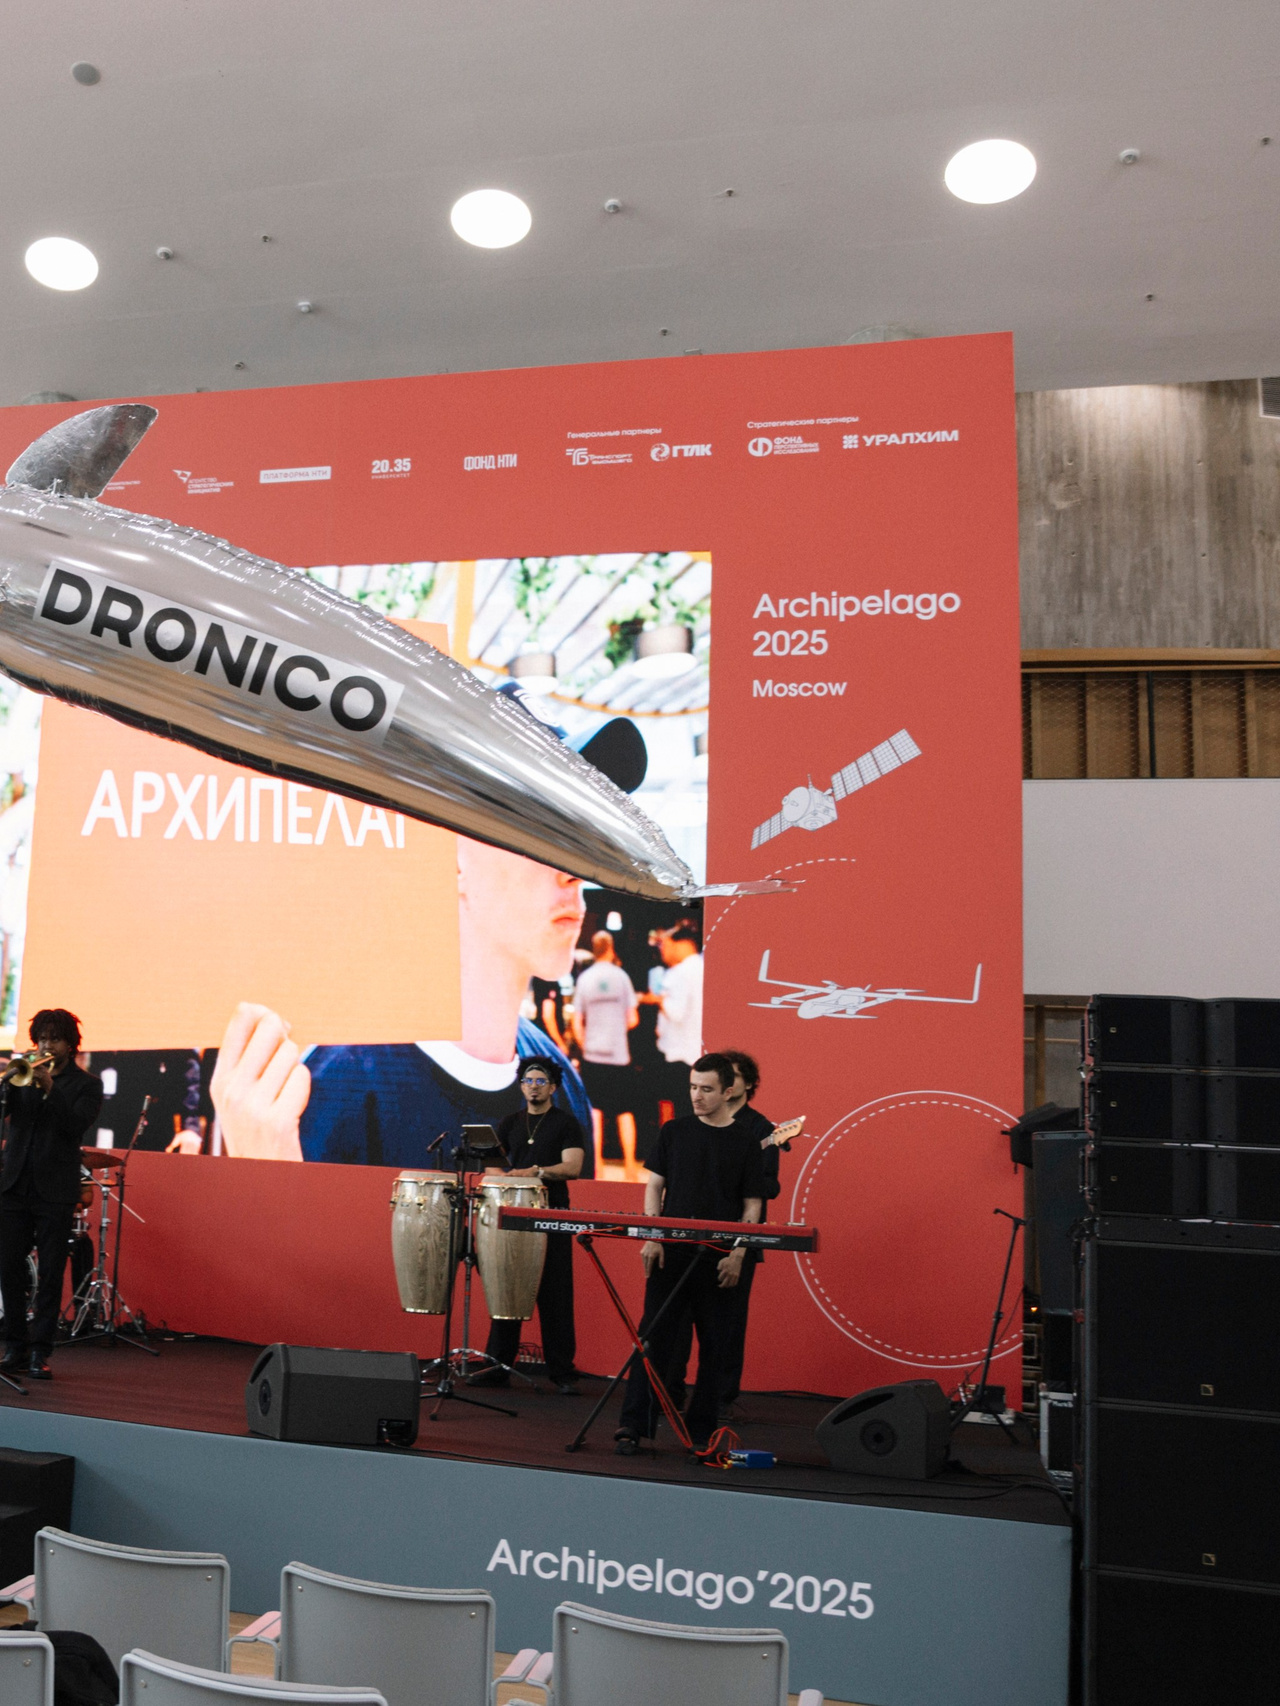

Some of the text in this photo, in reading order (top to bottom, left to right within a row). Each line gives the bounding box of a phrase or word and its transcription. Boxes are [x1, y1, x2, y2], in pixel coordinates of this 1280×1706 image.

[773, 436, 803, 445] ФОНД
[862, 430, 959, 446] УРАЛХИМ
[672, 444, 712, 457] ГТЛК
[371, 458, 411, 474] 20.35
[464, 454, 517, 471] ФОНД НТИ
[263, 470, 328, 480] ПЛАТФОРМА НТИ
[752, 589, 961, 622] Archipelago
[40, 568, 387, 732] DRONICO
[753, 629, 829, 656] 2025
[752, 680, 847, 697] Moscow
[534, 1221, 559, 1230] nord
[560, 1222, 587, 1233] stage
